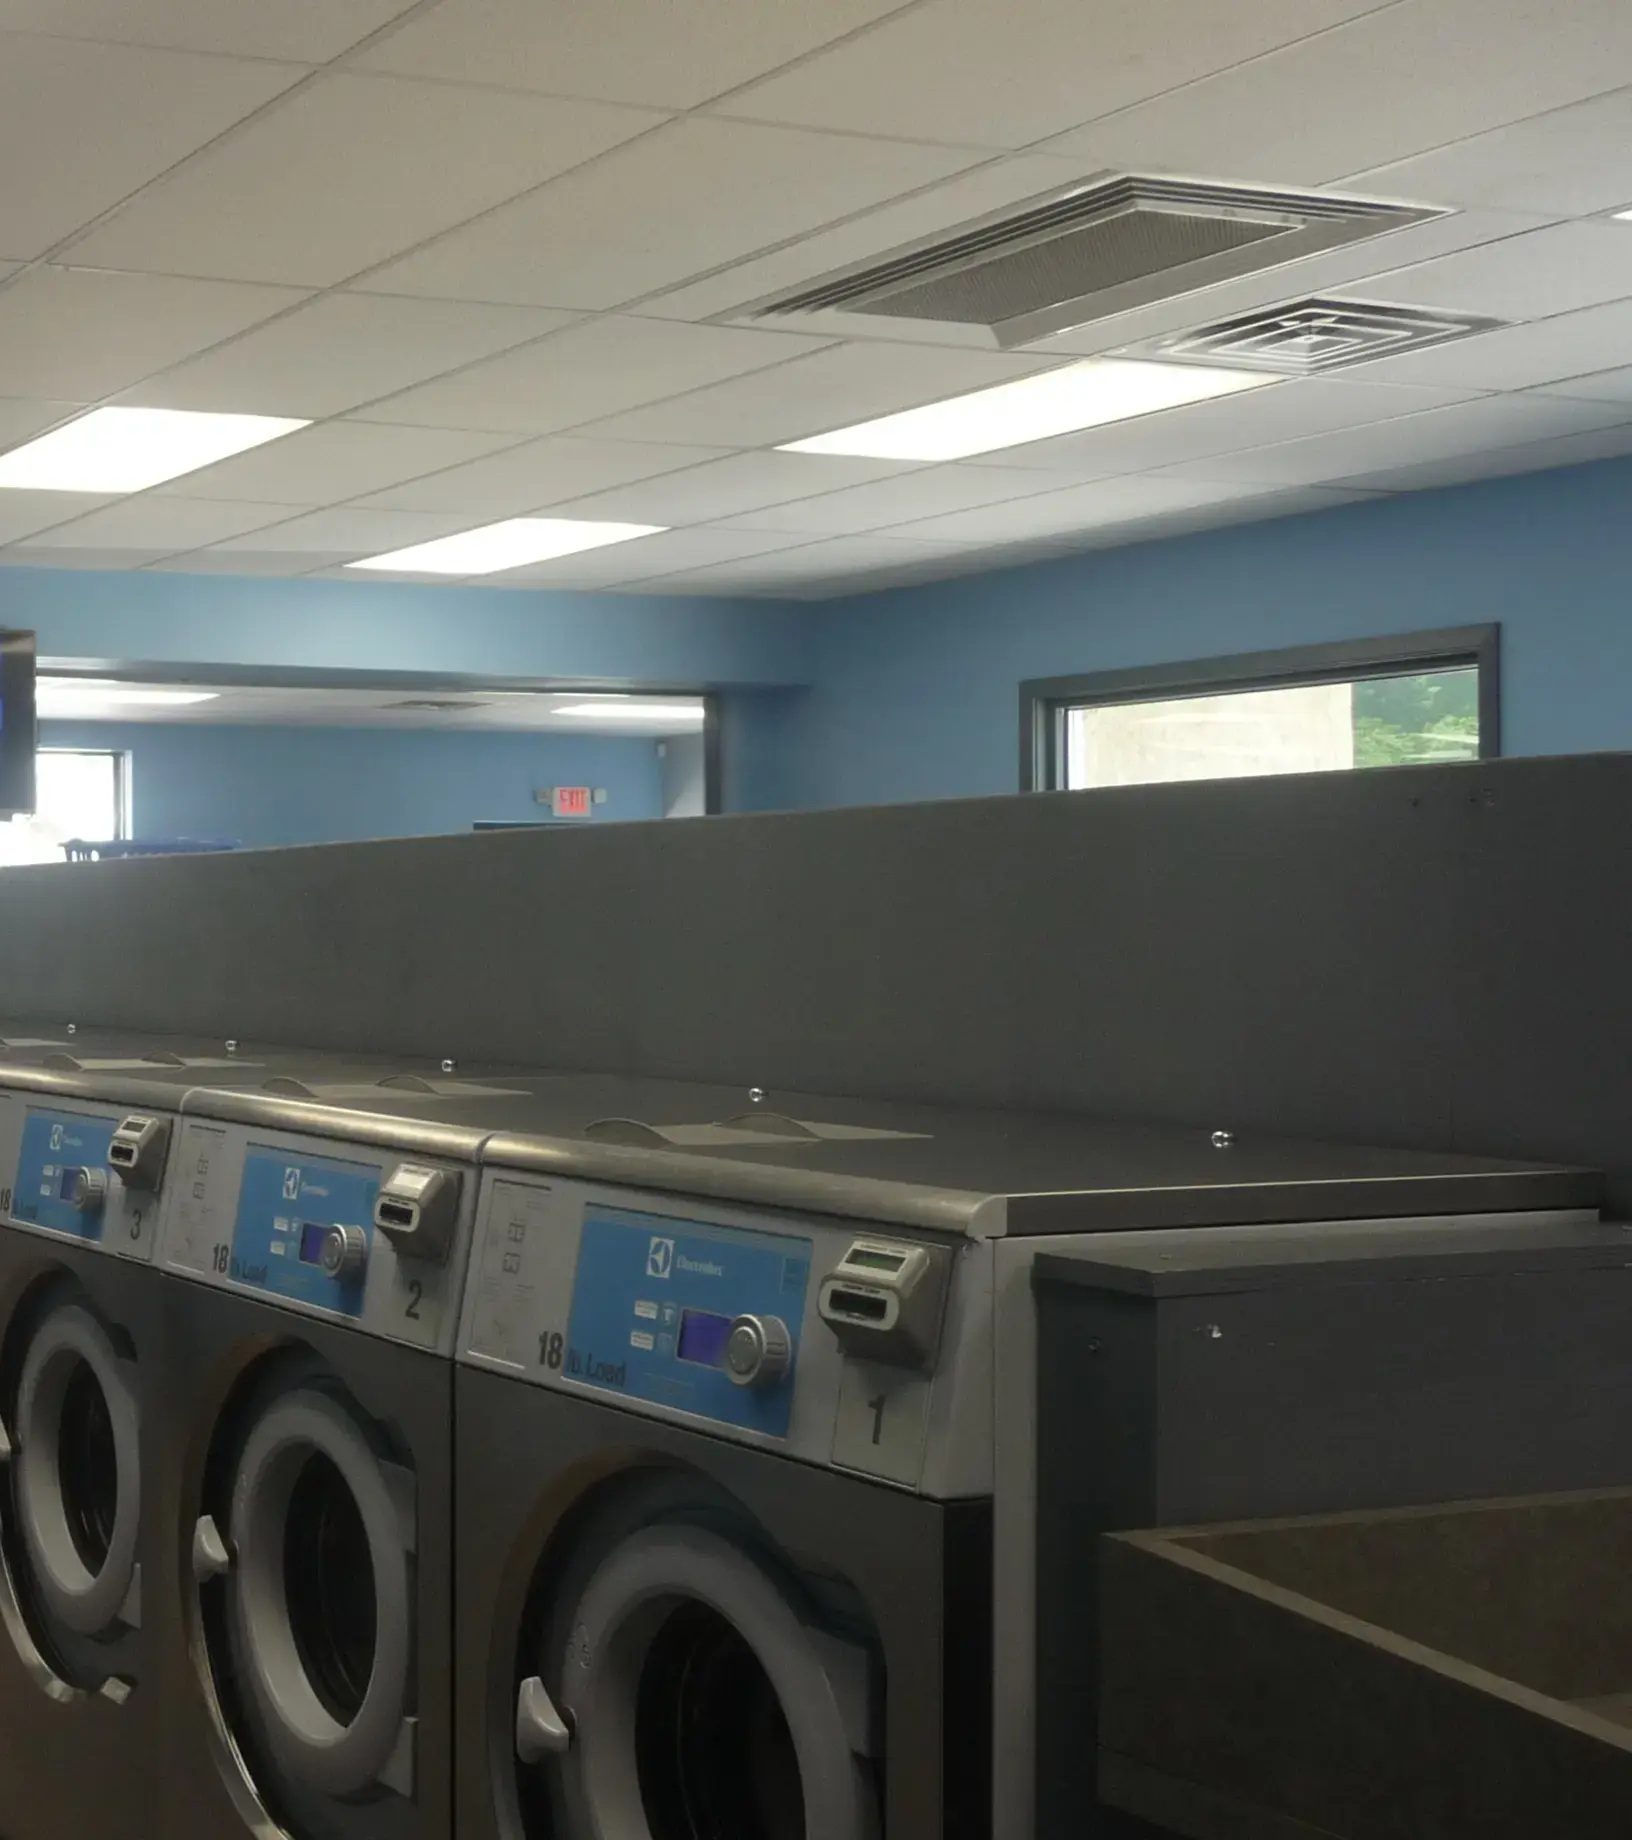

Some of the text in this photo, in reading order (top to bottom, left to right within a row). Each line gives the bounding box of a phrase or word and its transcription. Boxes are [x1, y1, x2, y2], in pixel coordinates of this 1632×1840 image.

[0, 1188, 12, 1212] 18
[130, 1208, 142, 1240] 3
[213, 1243, 229, 1274] 18
[405, 1279, 423, 1320] 2
[538, 1330, 563, 1370] 18
[868, 1393, 886, 1445] 1
